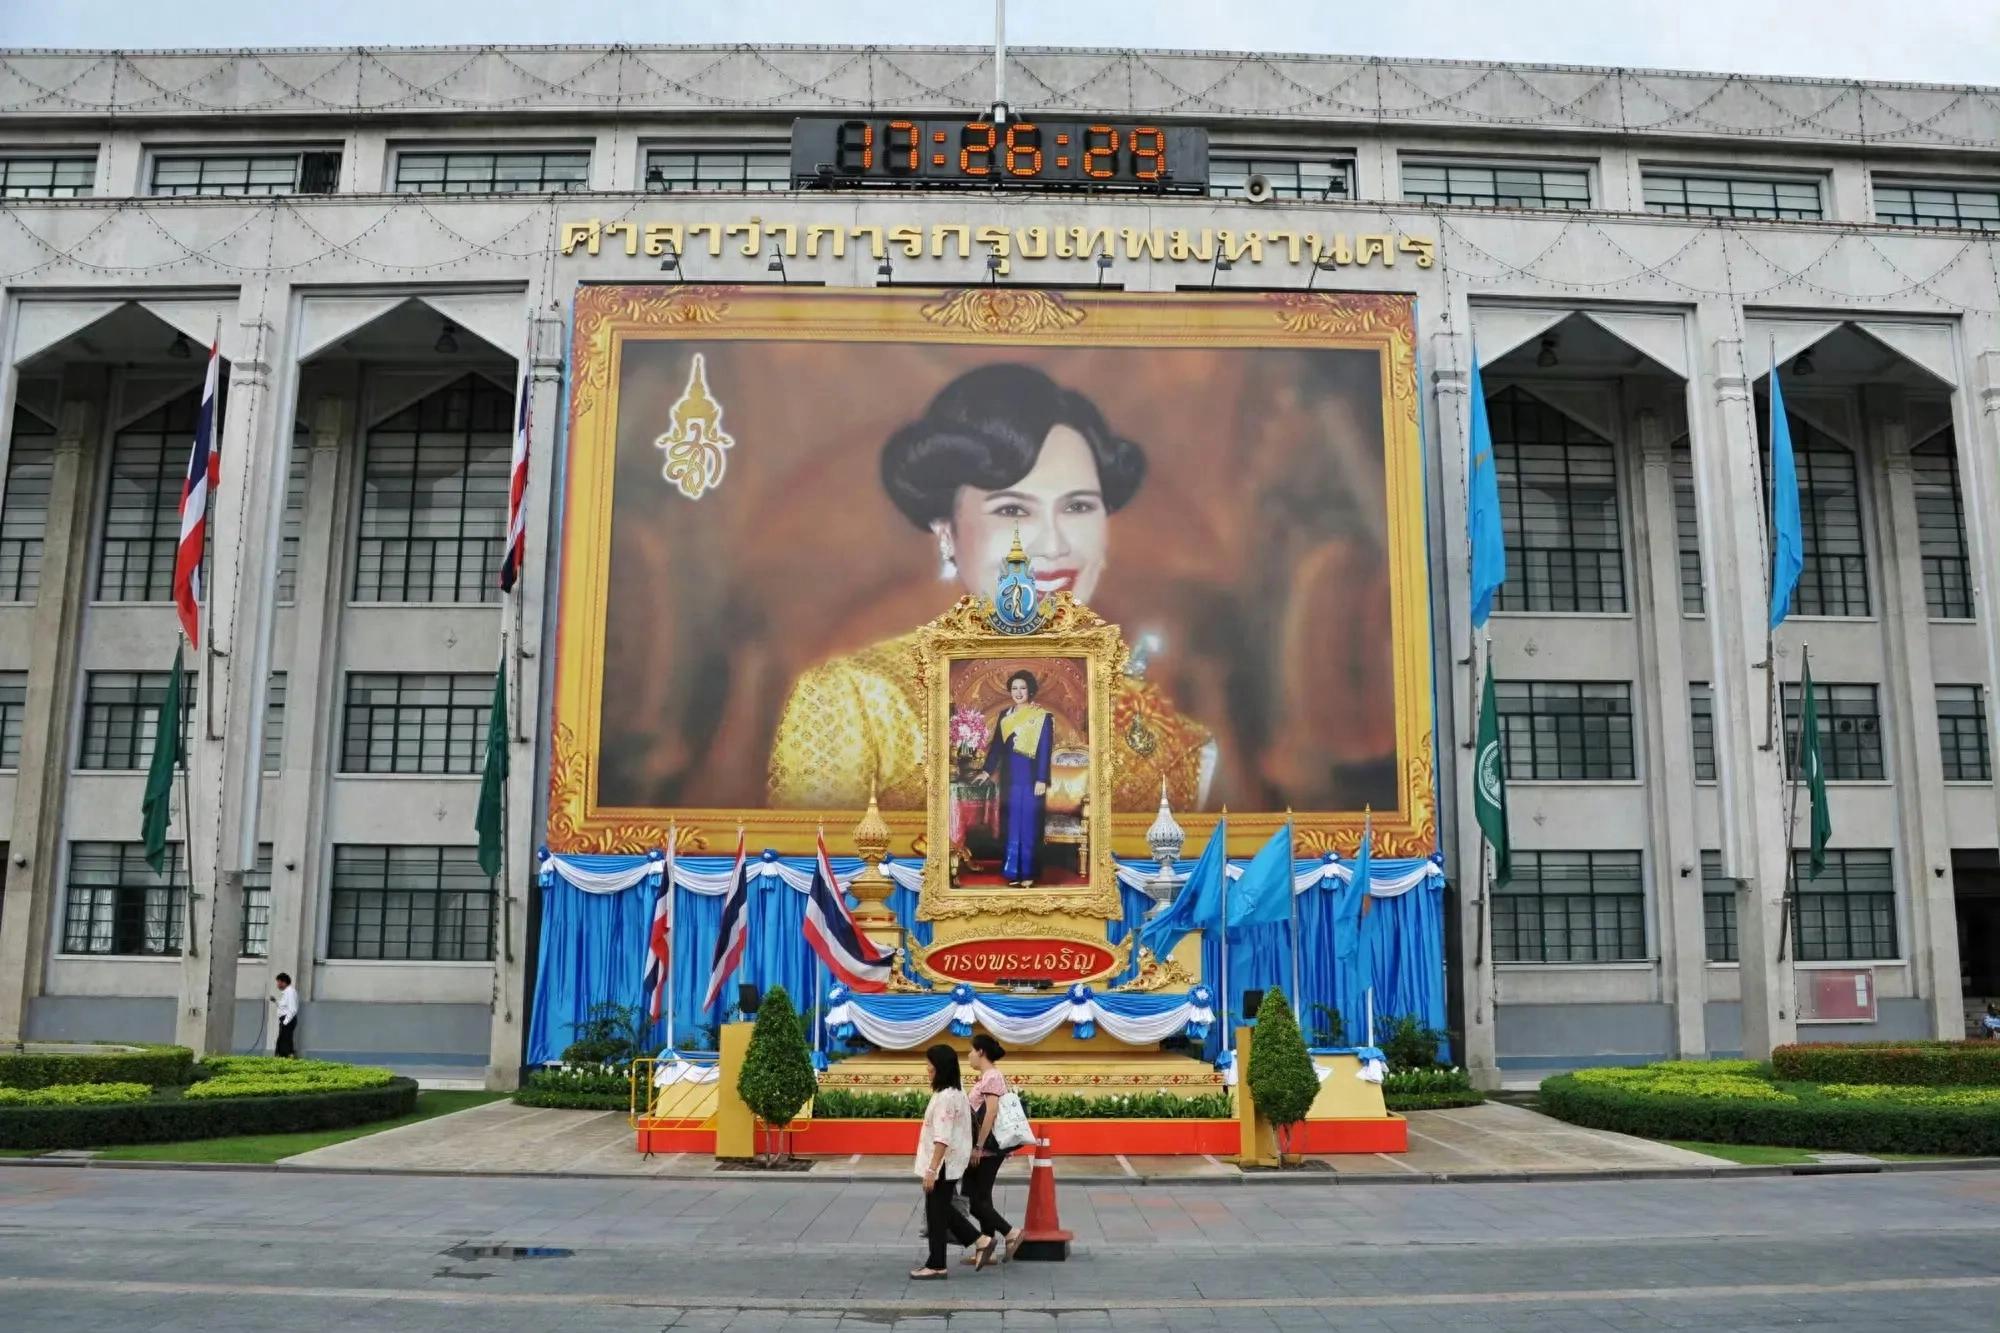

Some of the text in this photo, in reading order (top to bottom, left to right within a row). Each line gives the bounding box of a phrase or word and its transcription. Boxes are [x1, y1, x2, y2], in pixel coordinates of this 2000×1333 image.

[864, 120, 1165, 179] 17:26:29
[561, 216, 1435, 274] ศาลาว่าการกรุงเทพมหานคร
[944, 947, 1096, 975] ทรงพระเจริญ
